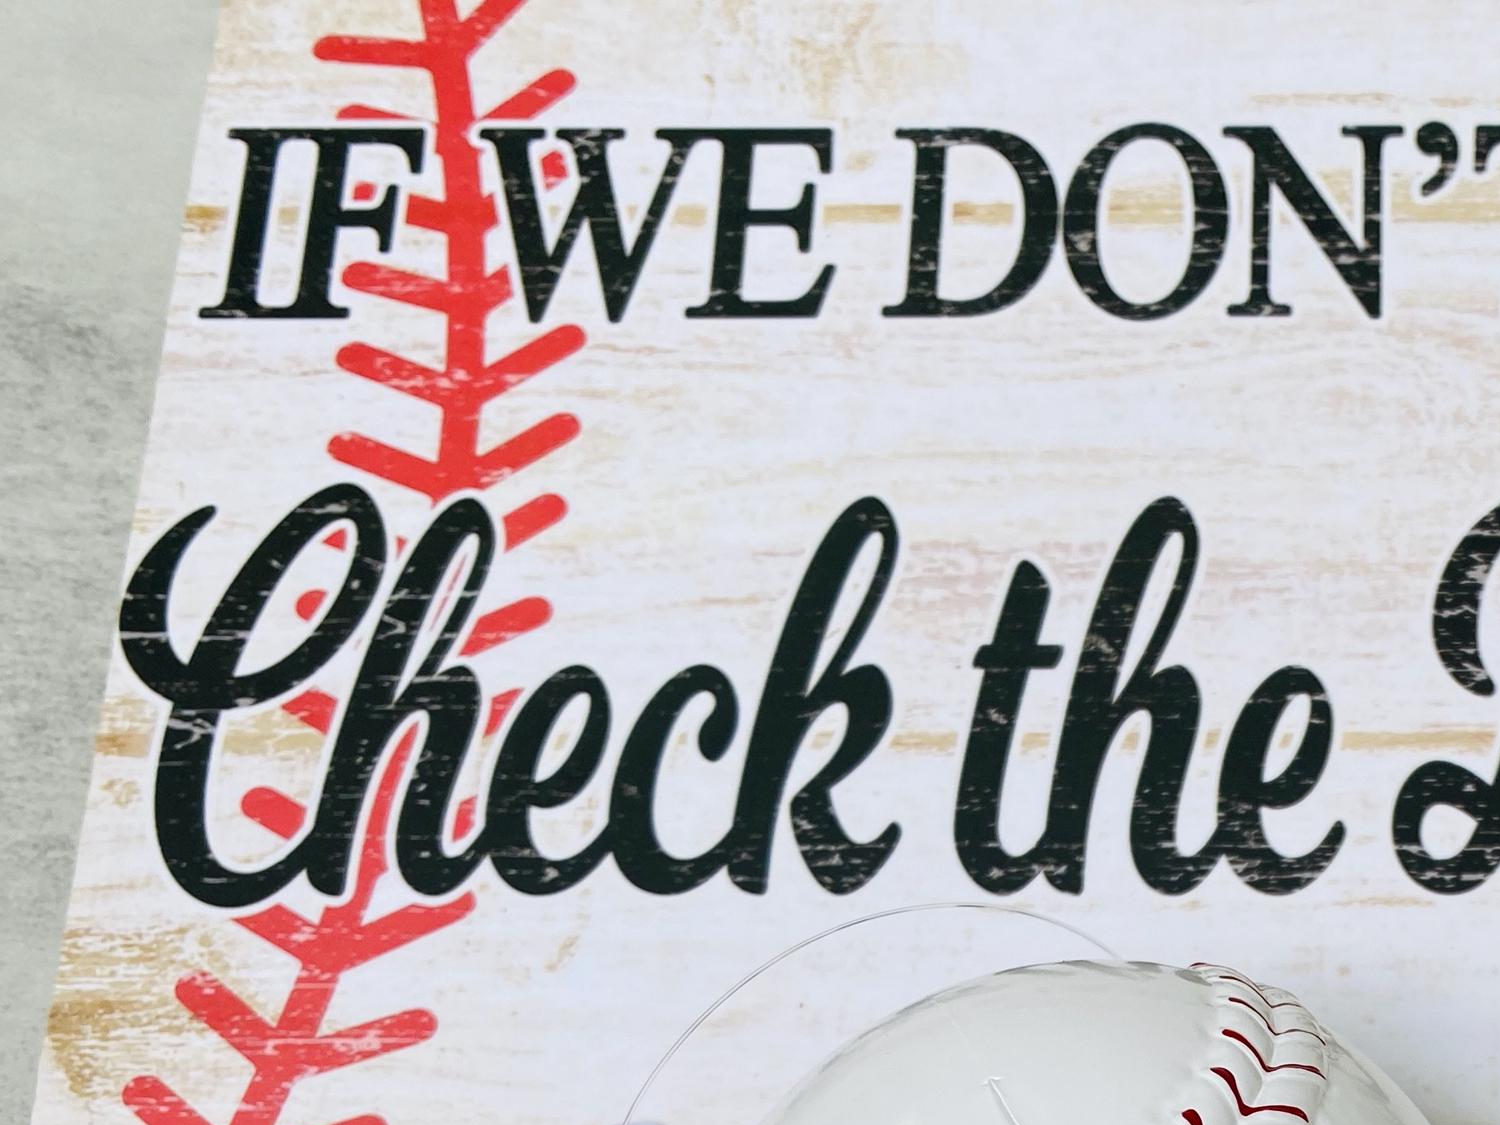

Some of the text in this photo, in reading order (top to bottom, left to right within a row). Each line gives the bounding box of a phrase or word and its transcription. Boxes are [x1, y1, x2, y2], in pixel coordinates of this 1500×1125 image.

[198, 127, 426, 319] IF
[479, 127, 836, 323] WE
[118, 482, 902, 908] Check
[953, 496, 1346, 895] the
